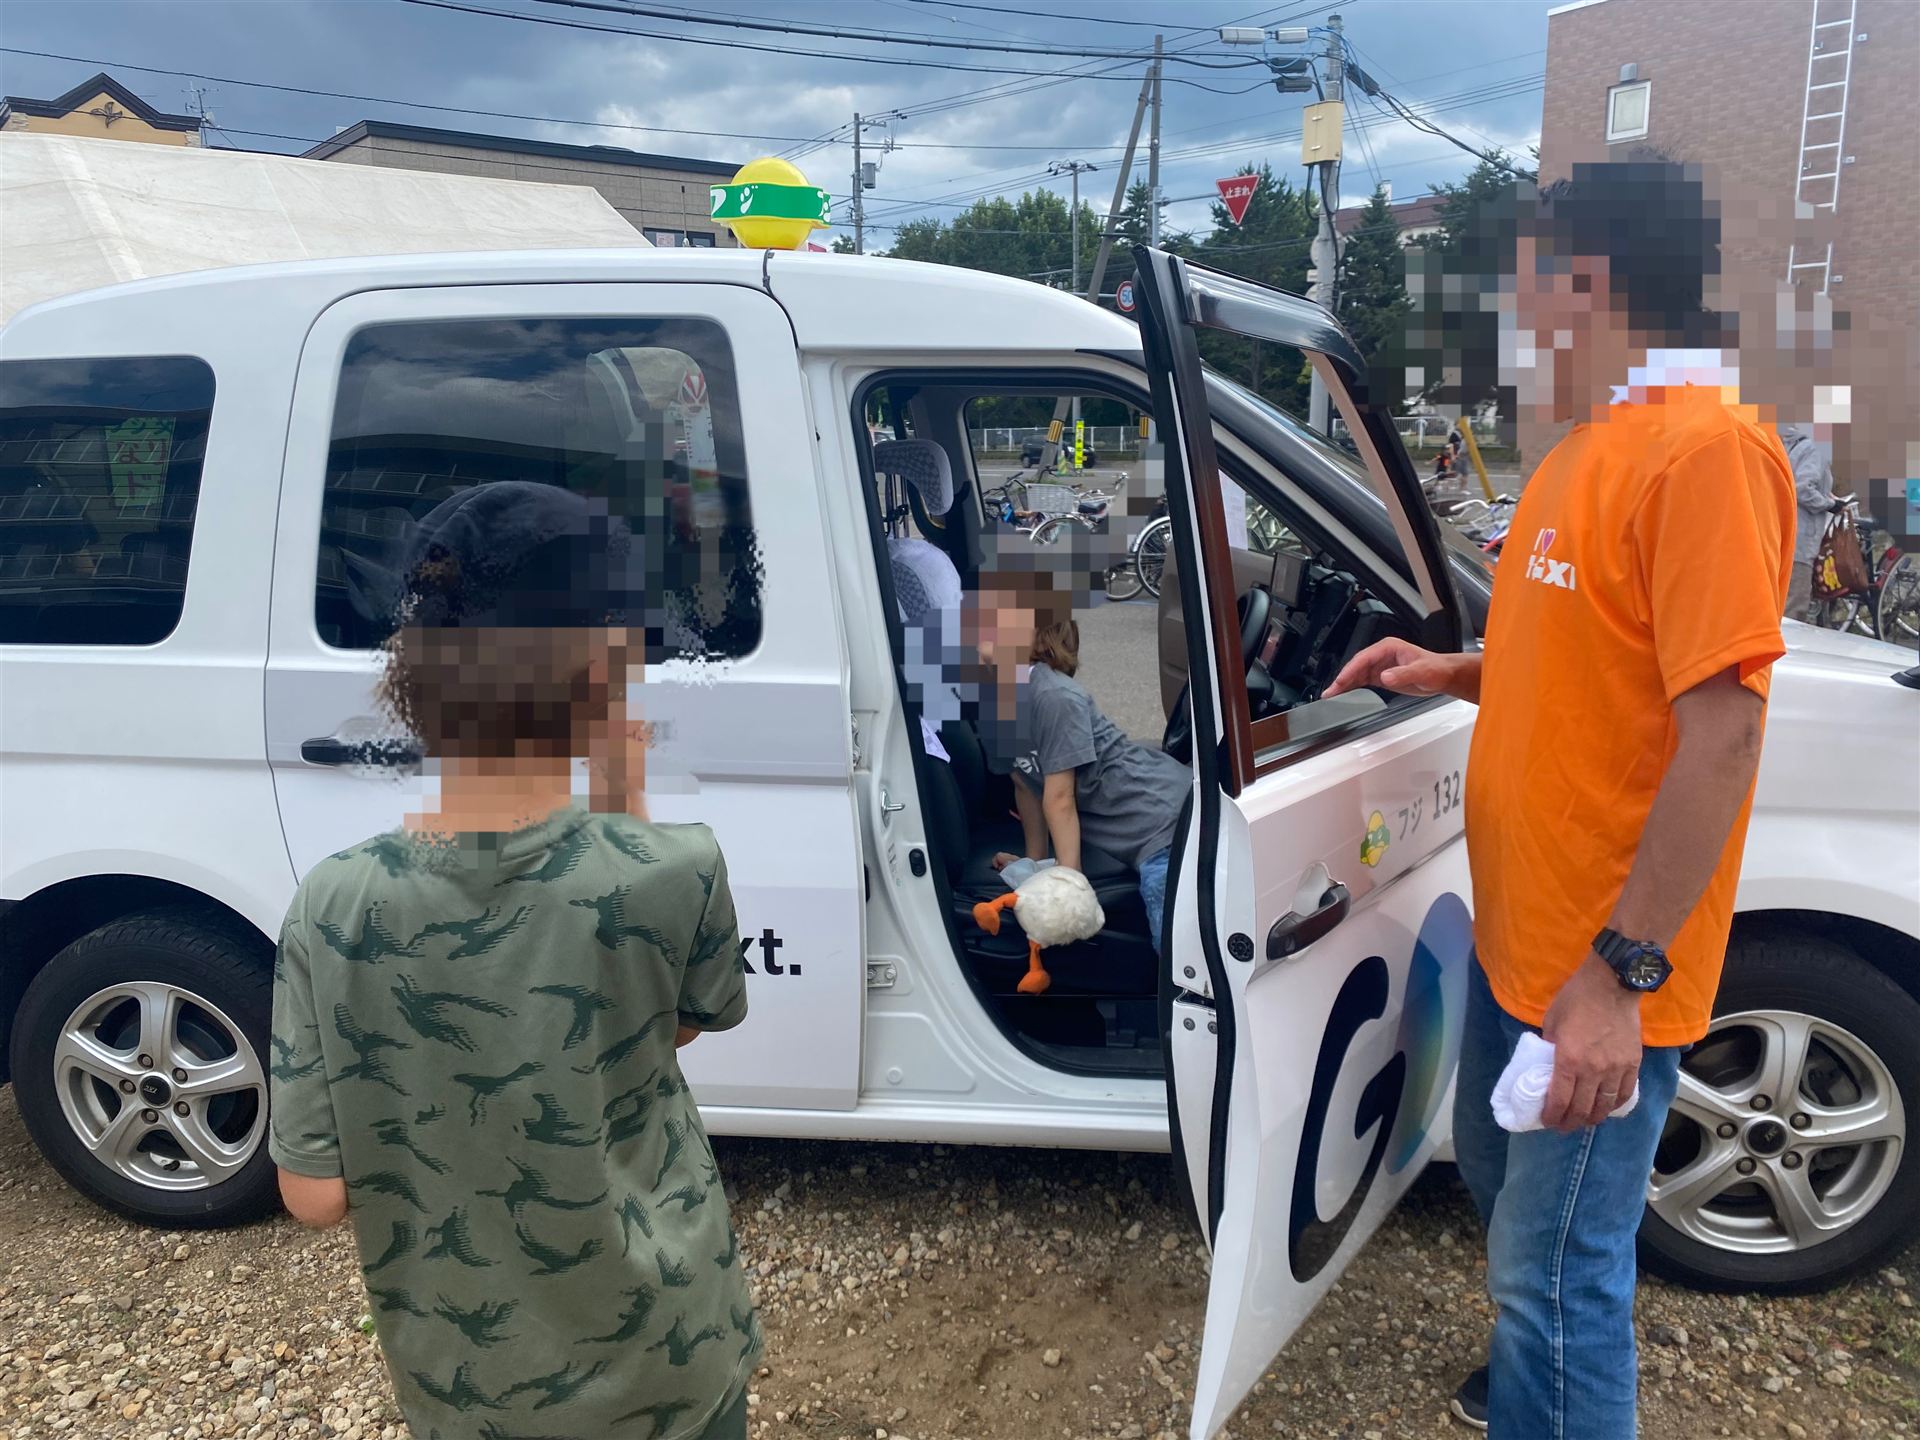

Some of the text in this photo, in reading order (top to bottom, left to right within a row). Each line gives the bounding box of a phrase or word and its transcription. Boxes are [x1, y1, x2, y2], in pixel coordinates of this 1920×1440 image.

[1225, 185, 1251, 198] 止まれ
[1399, 770, 1460, 840] フジ 132
